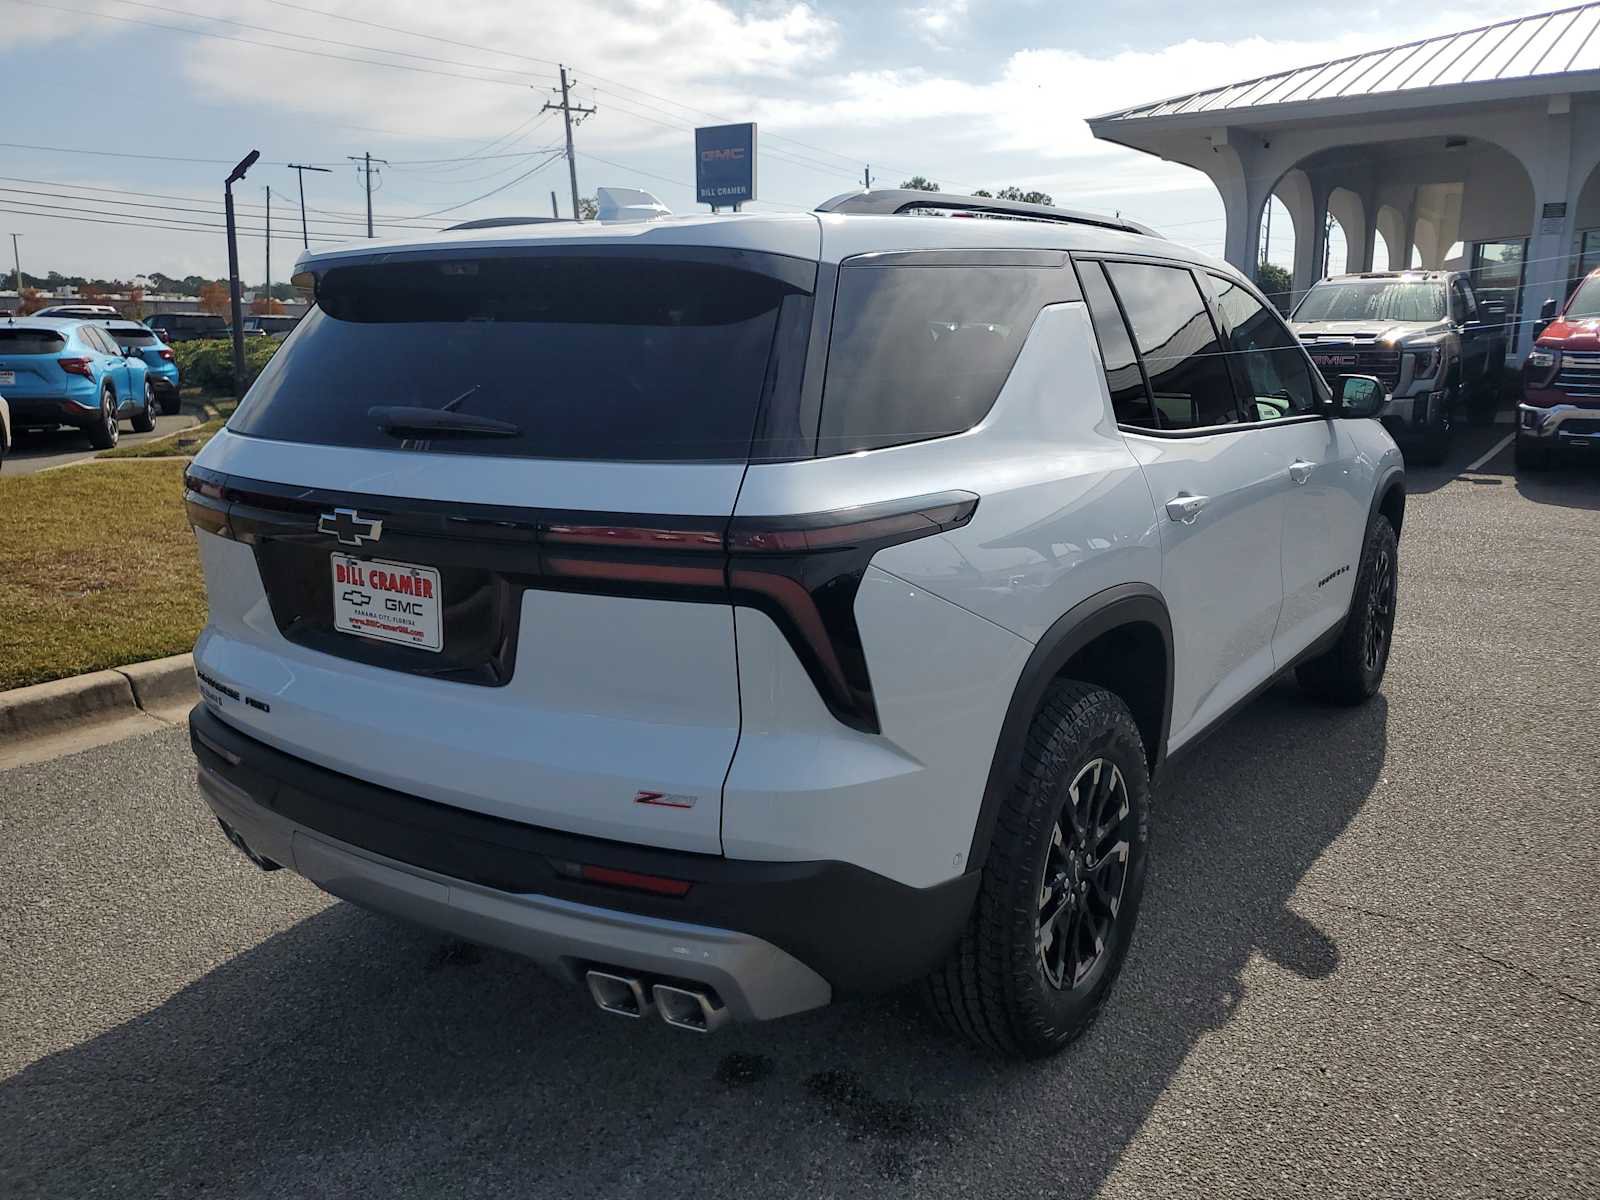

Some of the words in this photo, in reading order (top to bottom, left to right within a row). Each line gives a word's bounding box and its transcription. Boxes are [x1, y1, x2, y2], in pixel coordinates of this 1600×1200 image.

[702, 147, 745, 161] GMC
[701, 188, 716, 197] BILL
[718, 186, 746, 196] CRAMER
[336, 564, 365, 587] BILL
[369, 570, 433, 598] CRAMER
[385, 598, 423, 616] GMC
[354, 609, 377, 618] PANAMA
[393, 616, 415, 626] FLORIDA
